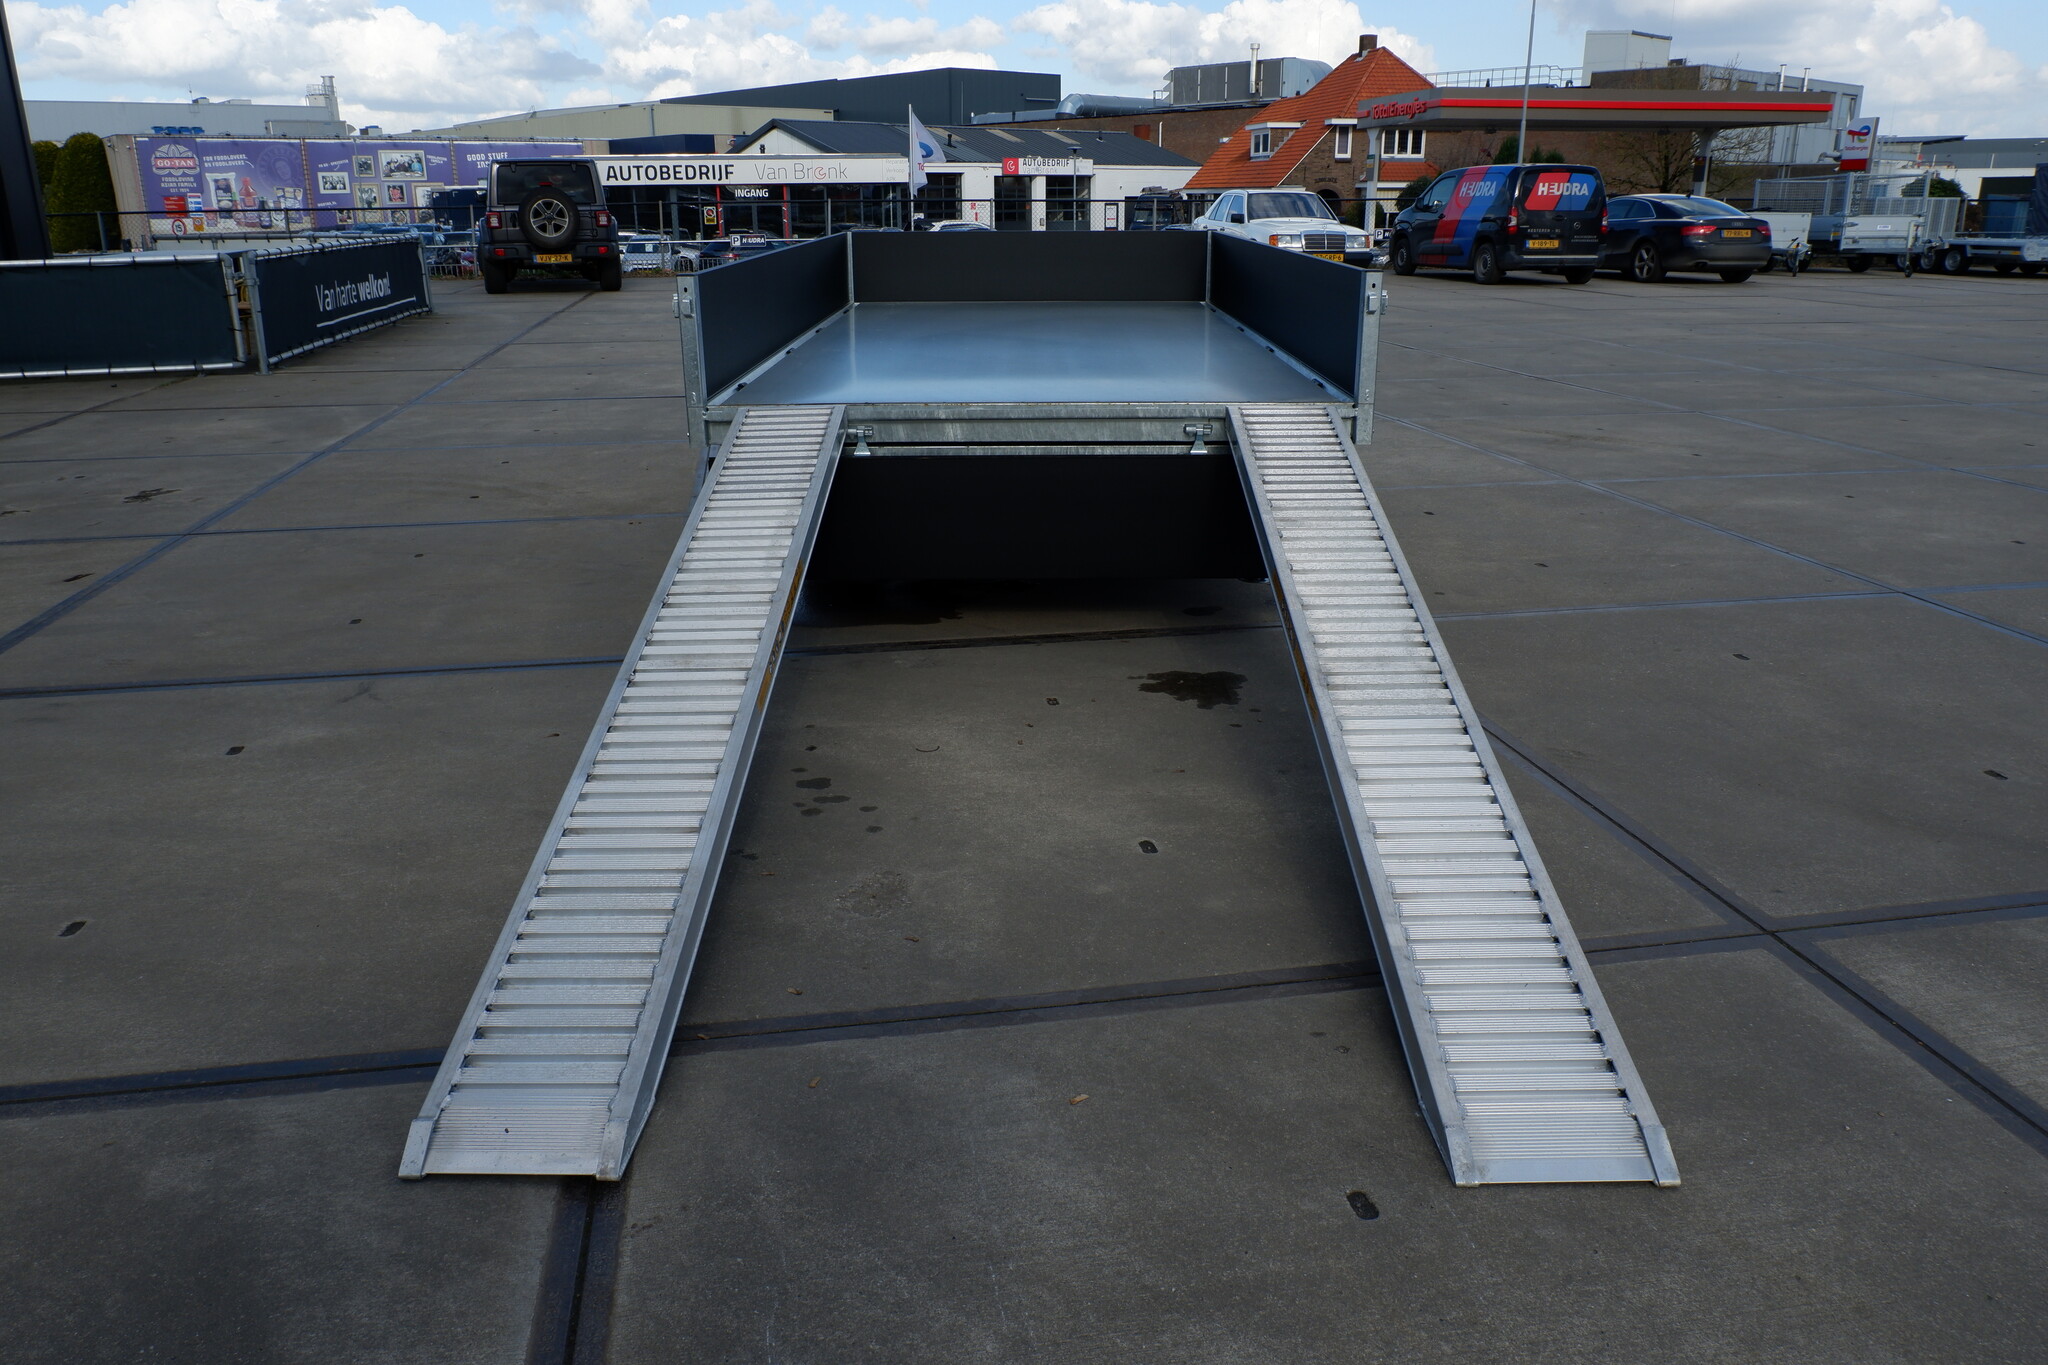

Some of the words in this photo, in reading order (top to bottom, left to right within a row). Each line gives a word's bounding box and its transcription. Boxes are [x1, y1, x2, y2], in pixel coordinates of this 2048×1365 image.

[1372, 97, 1427, 119] TotalEnergies
[466, 153, 486, 161] GOOD
[487, 152, 508, 160] STUFF
[1022, 159, 1070, 167] AUTOBEDRIJF
[606, 164, 735, 181] AUTOBEDRIJF
[754, 163, 788, 180] Van
[793, 162, 848, 180] Bronk
[735, 189, 769, 197] INGANG
[1459, 181, 1497, 197] HEUDRA
[1538, 182, 1589, 196] HEUDRA
[315, 284, 337, 312] Van
[335, 280, 358, 308] harte
